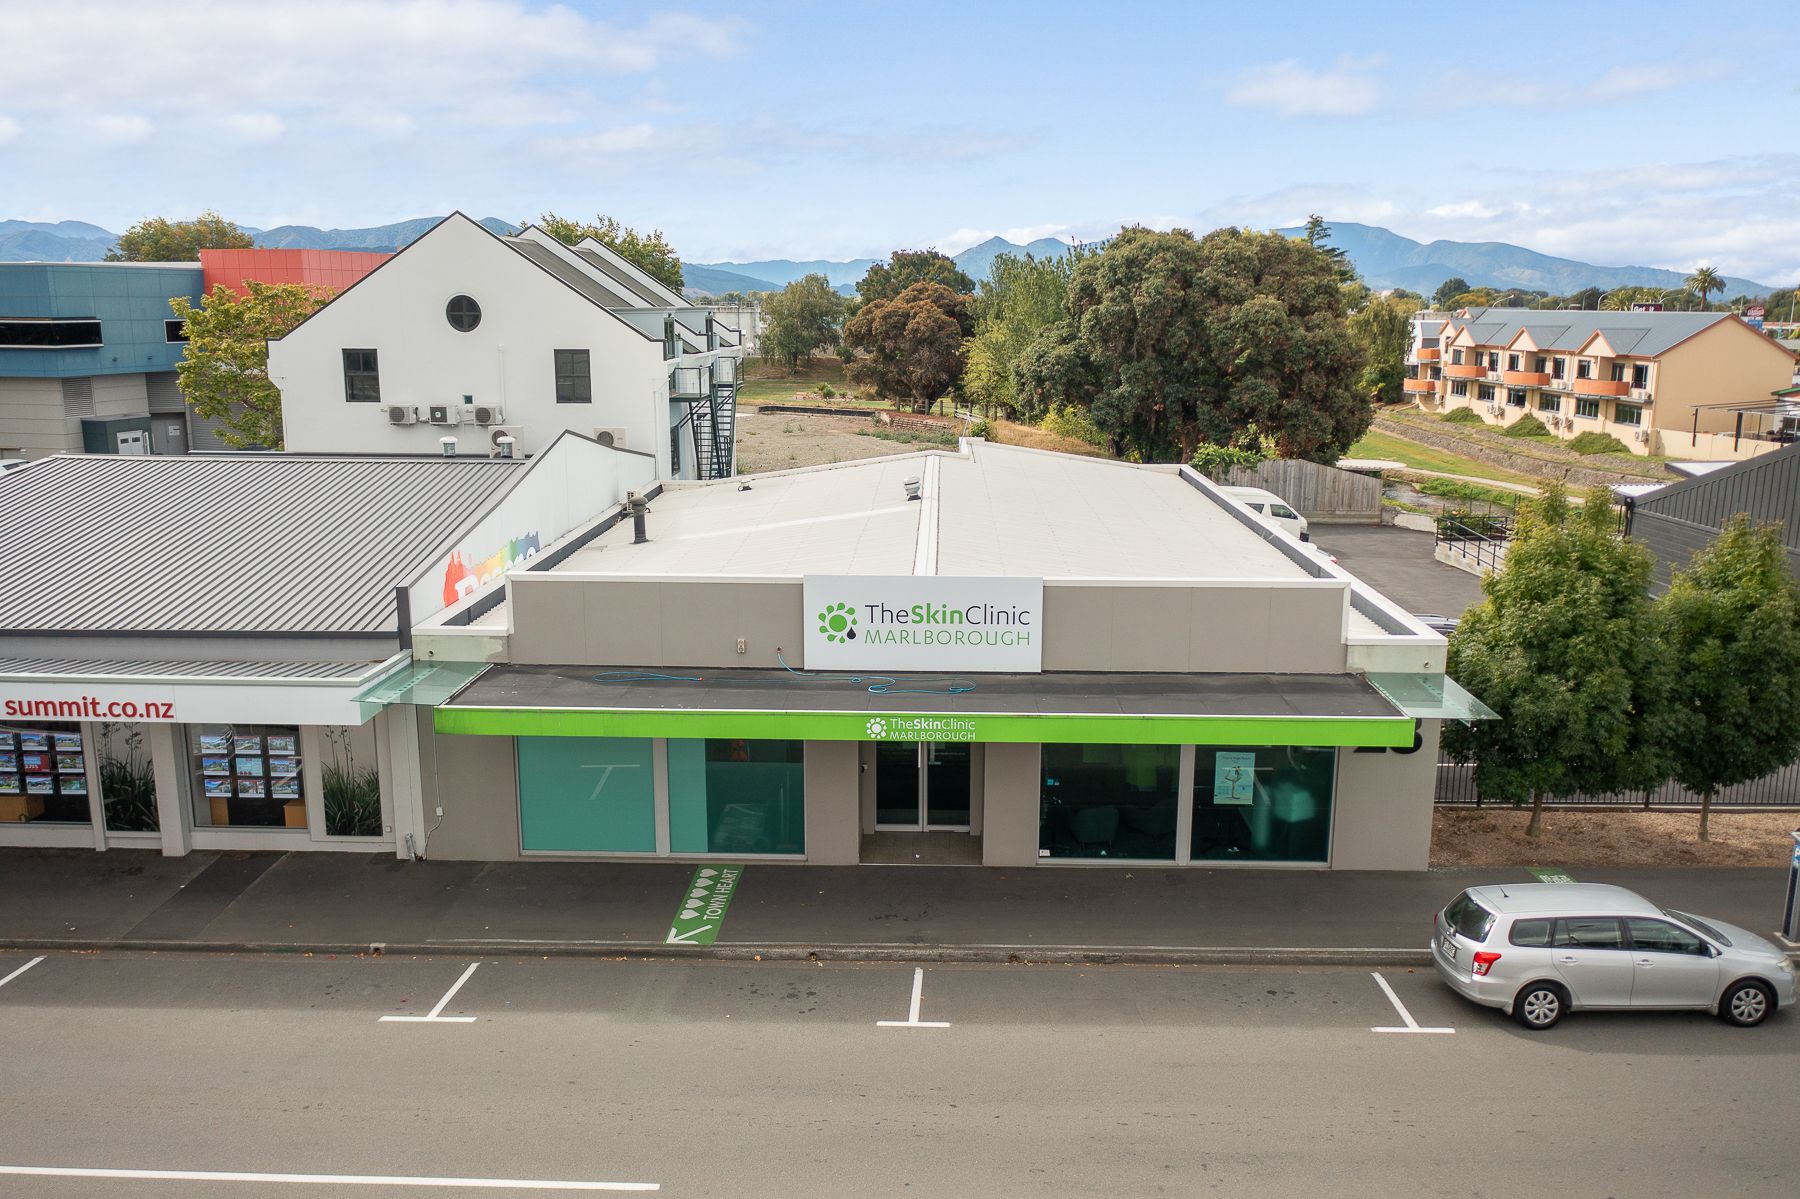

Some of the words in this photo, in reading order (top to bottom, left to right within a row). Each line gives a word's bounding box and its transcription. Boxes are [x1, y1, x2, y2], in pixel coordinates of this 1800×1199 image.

[864, 603, 1030, 625] TheSkinClinic
[864, 629, 1031, 646] MARLBOROUGH
[5, 696, 174, 719] summit.co.nz
[889, 717, 976, 731] TheSkinClinic
[889, 730, 976, 741] MARLBOROUGH
[715, 868, 740, 893] HEART
[703, 894, 729, 920] TOWN
